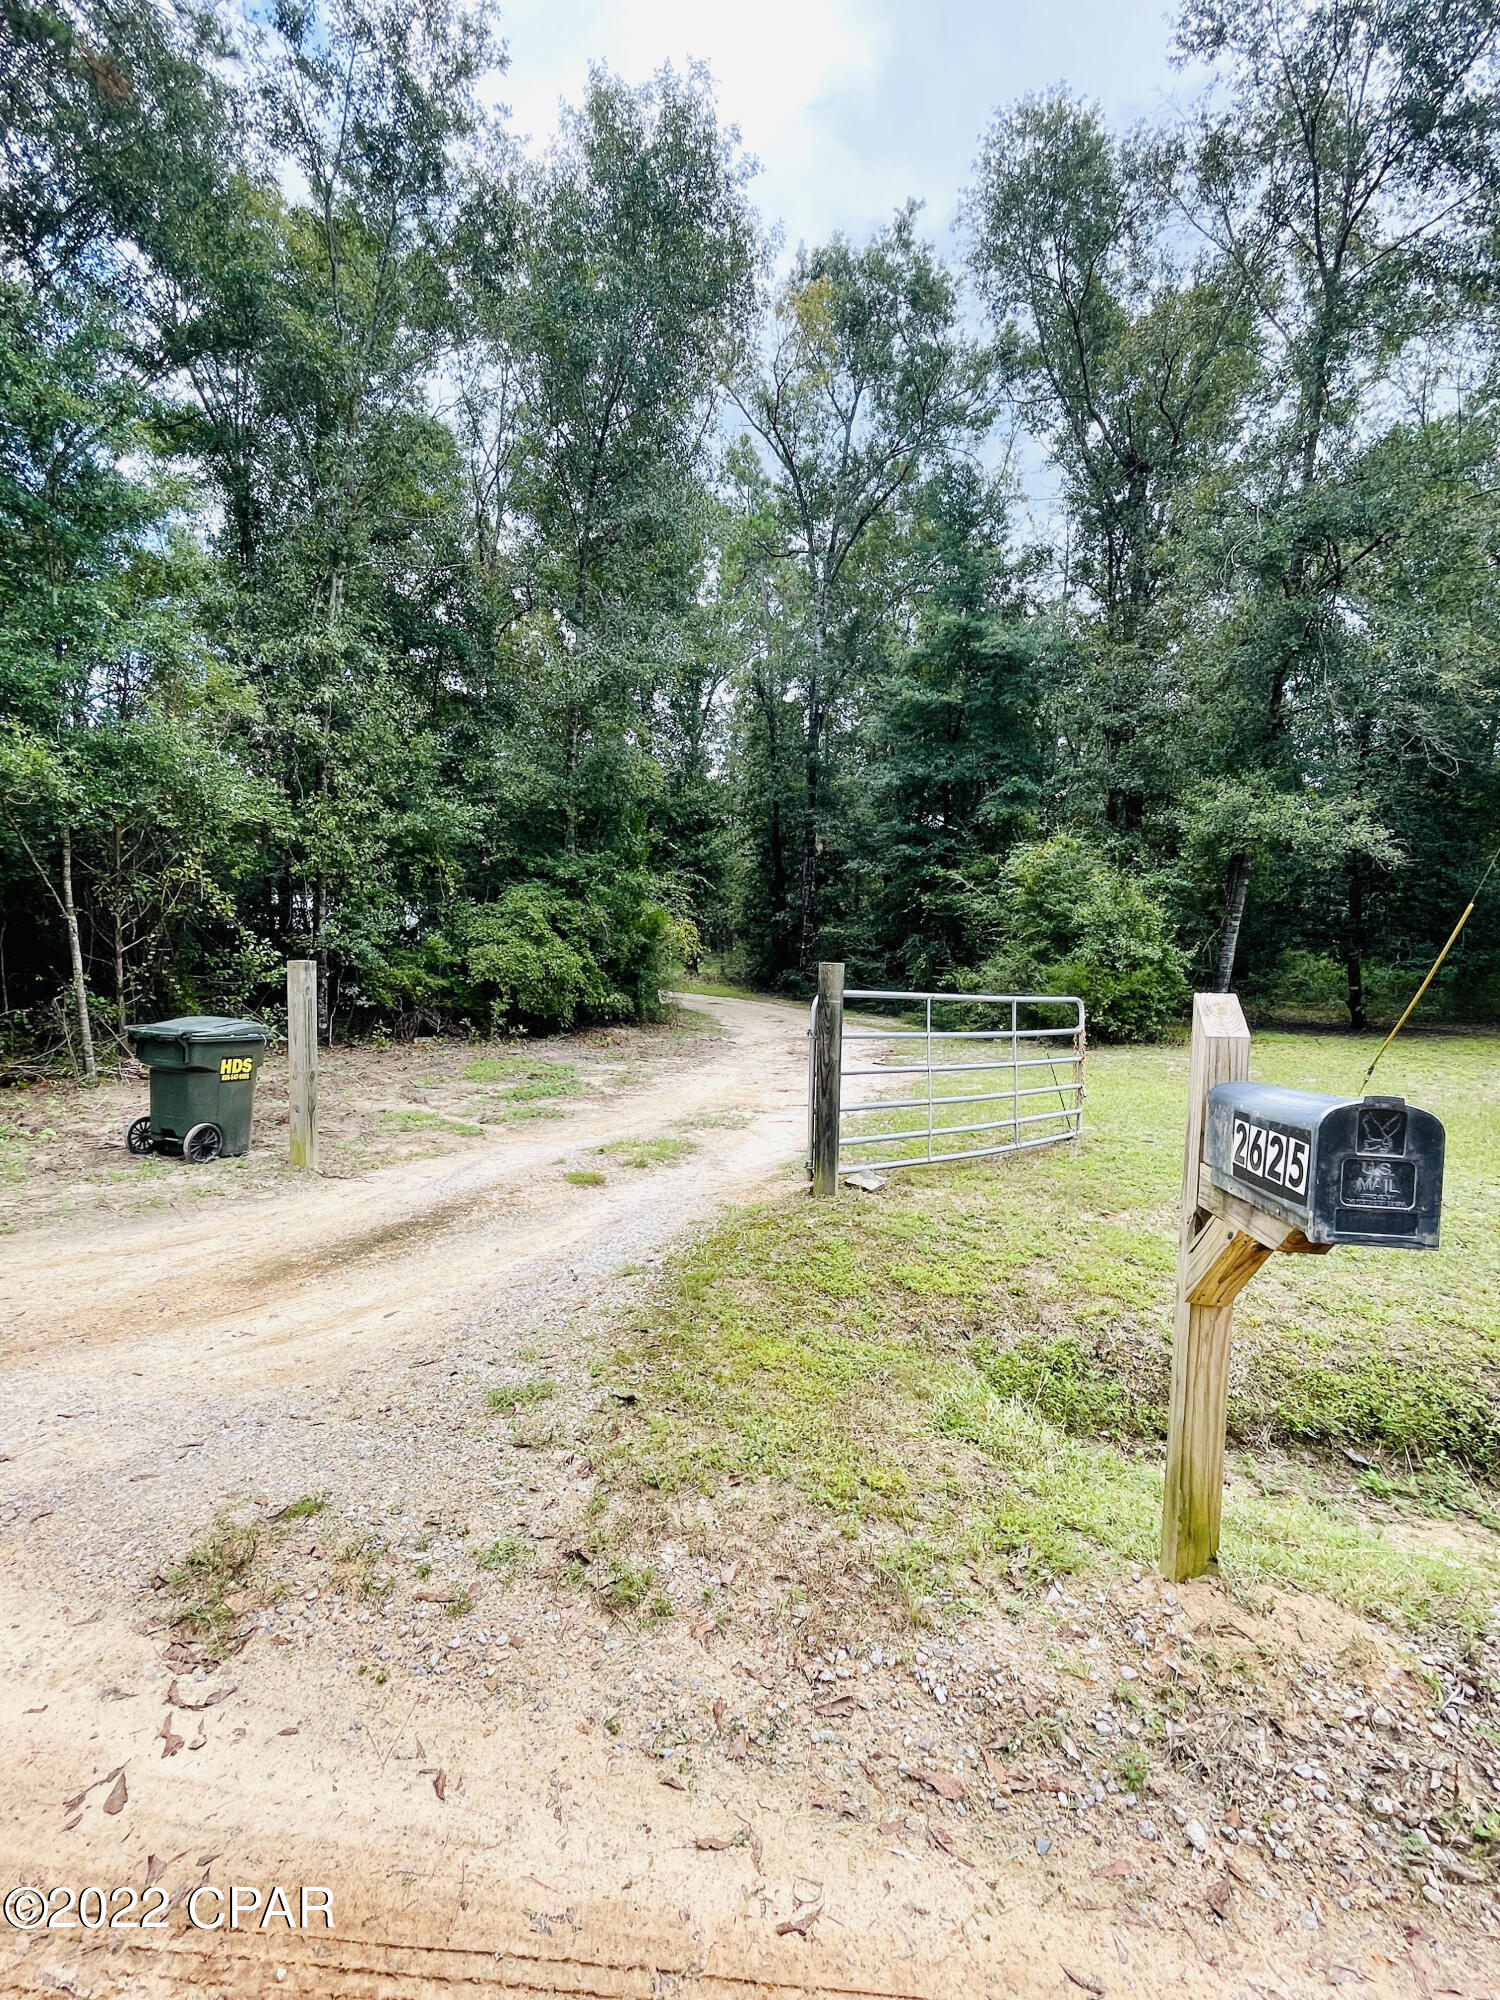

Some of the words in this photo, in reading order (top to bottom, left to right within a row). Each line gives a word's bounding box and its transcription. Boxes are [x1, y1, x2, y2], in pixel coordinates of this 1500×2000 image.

[220, 1057, 253, 1074] HDS
[1234, 1122, 1306, 1188] 2625
[1356, 1177, 1401, 1194] MAIL
